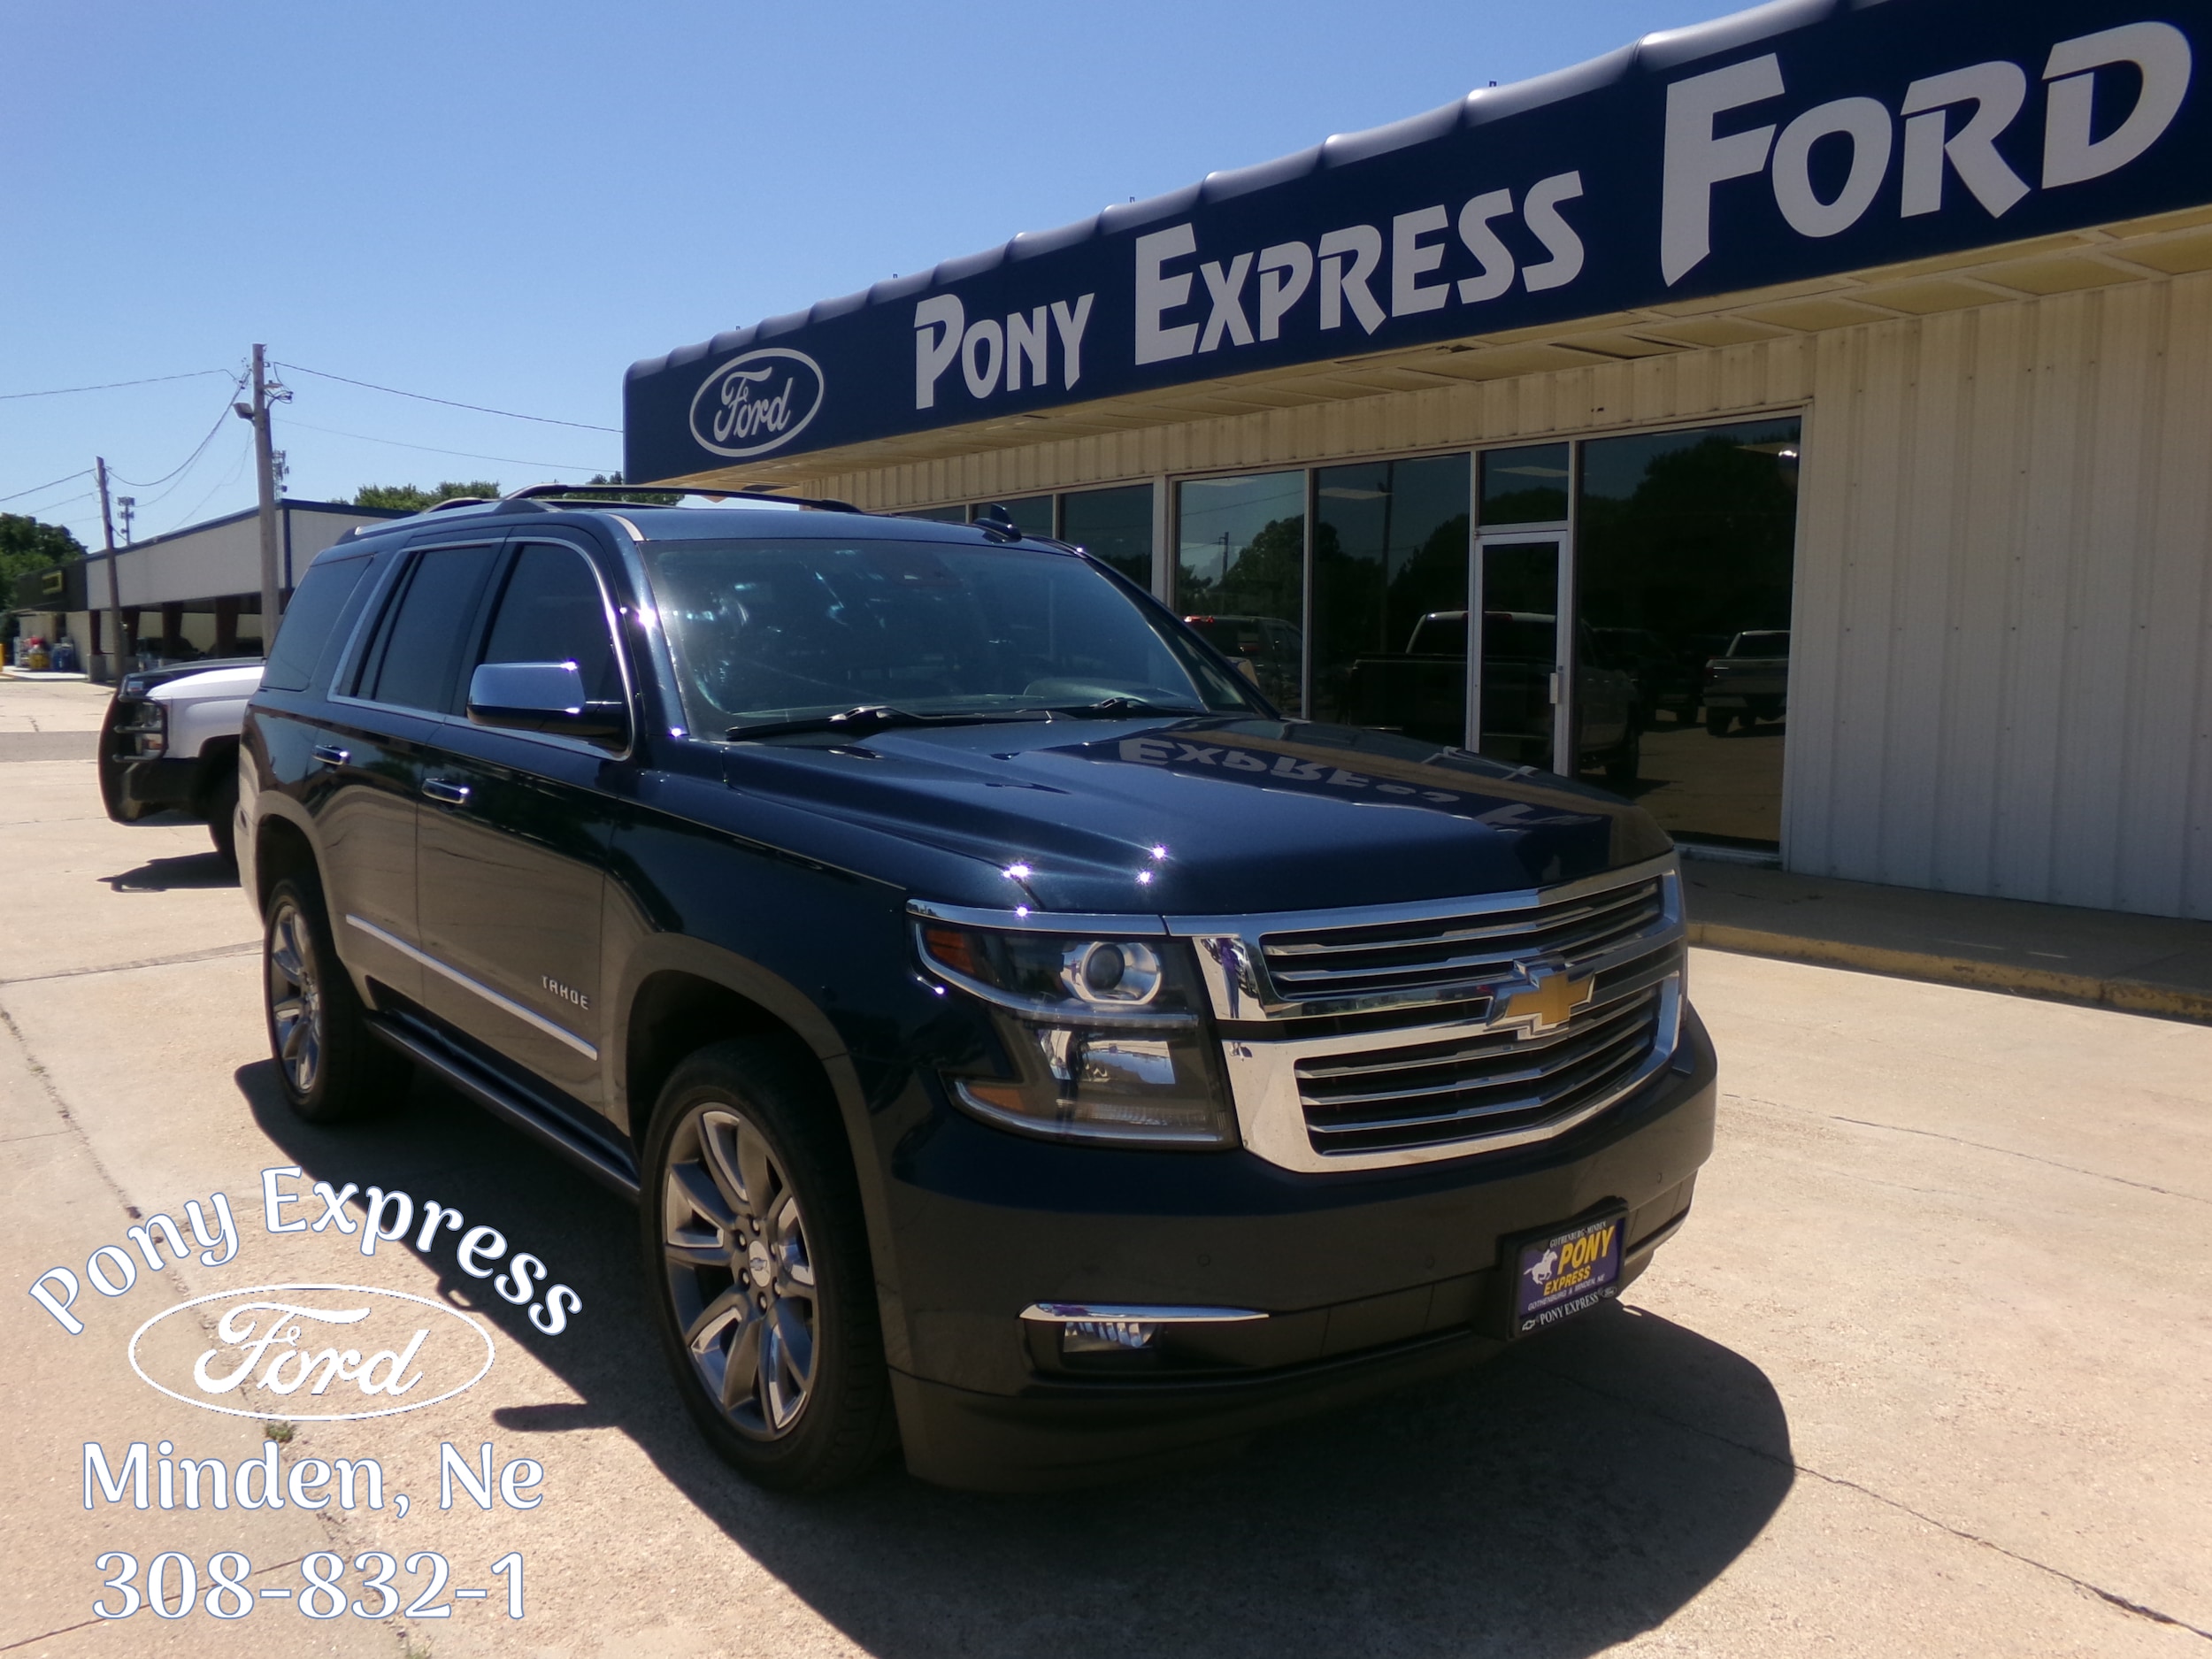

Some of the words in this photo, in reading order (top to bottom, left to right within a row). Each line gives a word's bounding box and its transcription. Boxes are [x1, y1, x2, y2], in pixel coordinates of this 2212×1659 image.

[914, 293, 1094, 410] PONY
[1134, 170, 1585, 365] EXPRESS
[1662, 21, 2192, 288] FORD
[714, 366, 793, 442] Ford
[541, 975, 589, 1010] TAHOE
[1557, 1225, 1616, 1275] PONY
[1543, 1266, 1591, 1296] EXPRESS
[1540, 1305, 1563, 1325] PONY
[1564, 1292, 1600, 1316] EXPRESS
